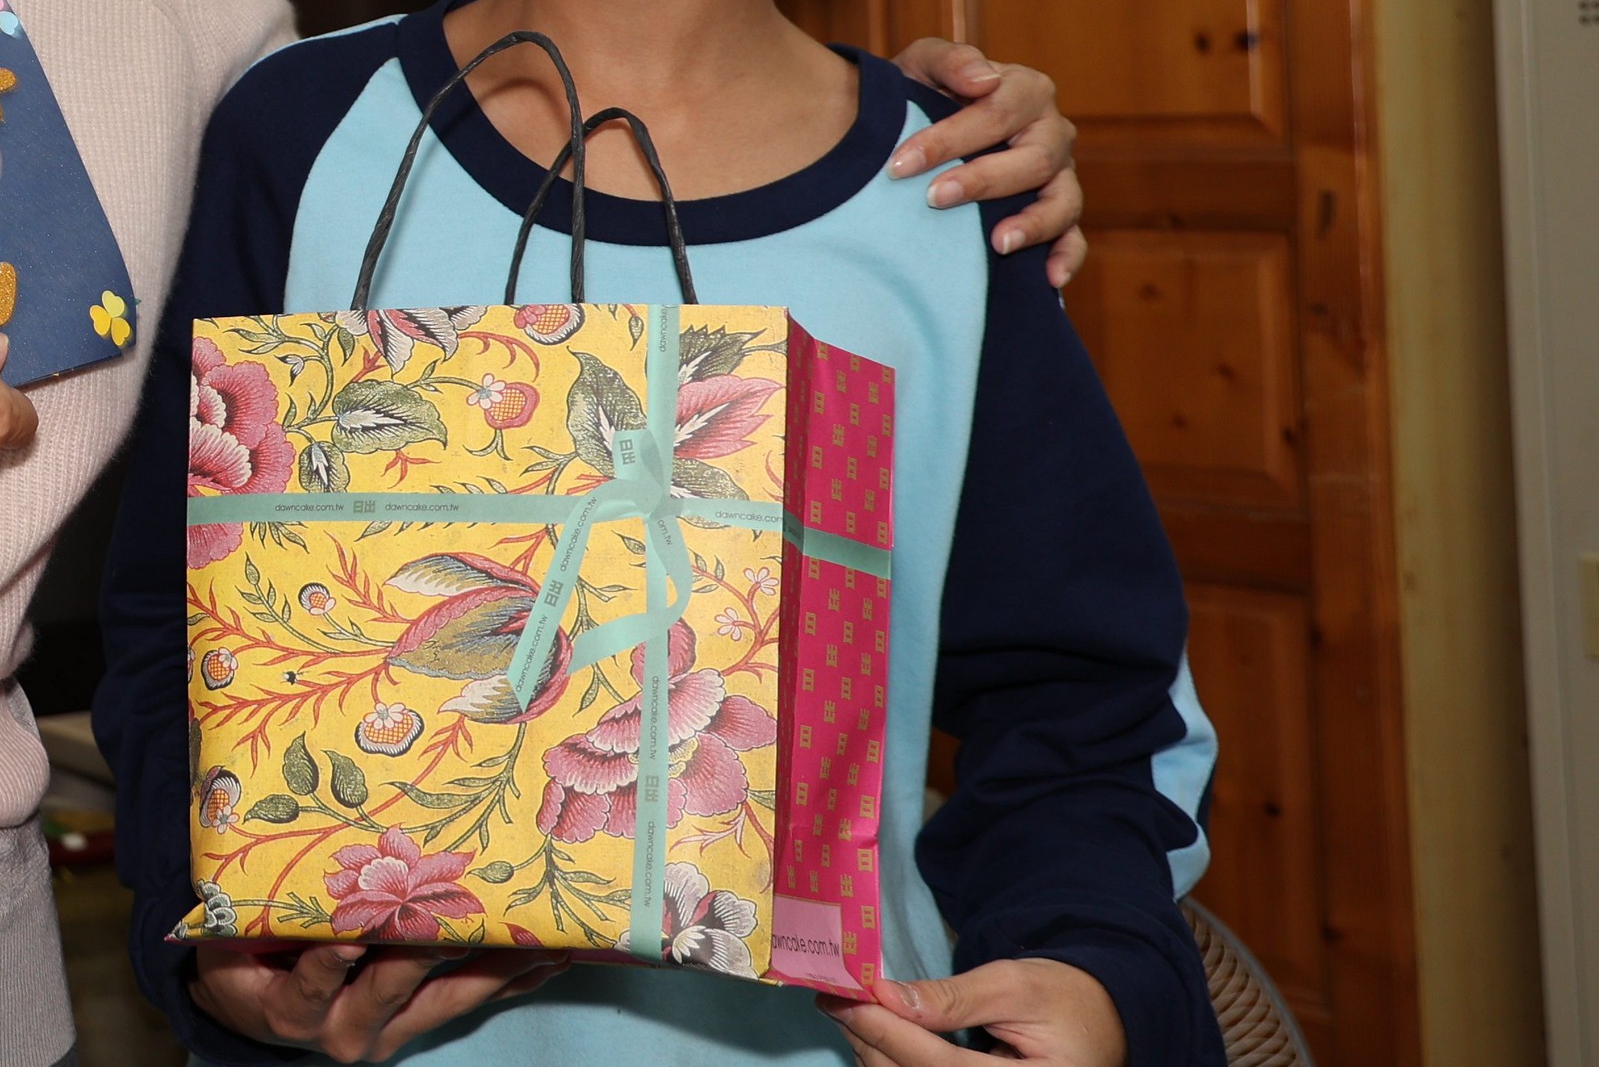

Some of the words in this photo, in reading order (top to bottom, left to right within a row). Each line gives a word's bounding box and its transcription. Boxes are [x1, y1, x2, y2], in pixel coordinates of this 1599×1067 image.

[619, 438, 636, 465] 日出
[274, 502, 345, 513] dawncake.com.tw
[352, 500, 376, 514] 日出
[384, 502, 460, 513] dawncake.com.tw
[515, 614, 548, 693] dawncake.com.tw
[544, 579, 564, 607] 日出
[560, 496, 597, 572] dawncake.com.tw
[649, 675, 660, 761] dawncake.com.tw
[644, 774, 659, 803] 日出
[643, 821, 655, 908] dawncake.com.tw
